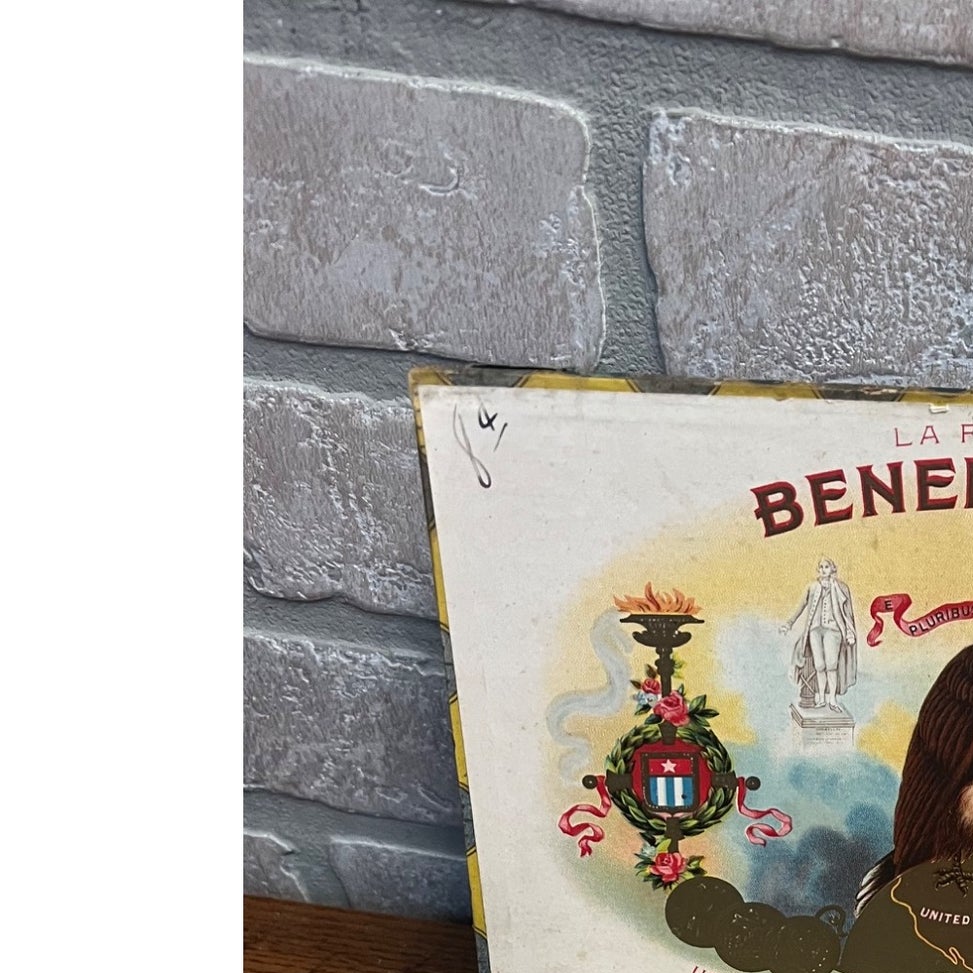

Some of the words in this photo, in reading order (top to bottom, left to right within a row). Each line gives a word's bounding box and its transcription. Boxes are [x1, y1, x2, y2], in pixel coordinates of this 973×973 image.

[894, 425, 940, 448] LA
[884, 600, 894, 612] E
[919, 906, 970, 926] UNITED
